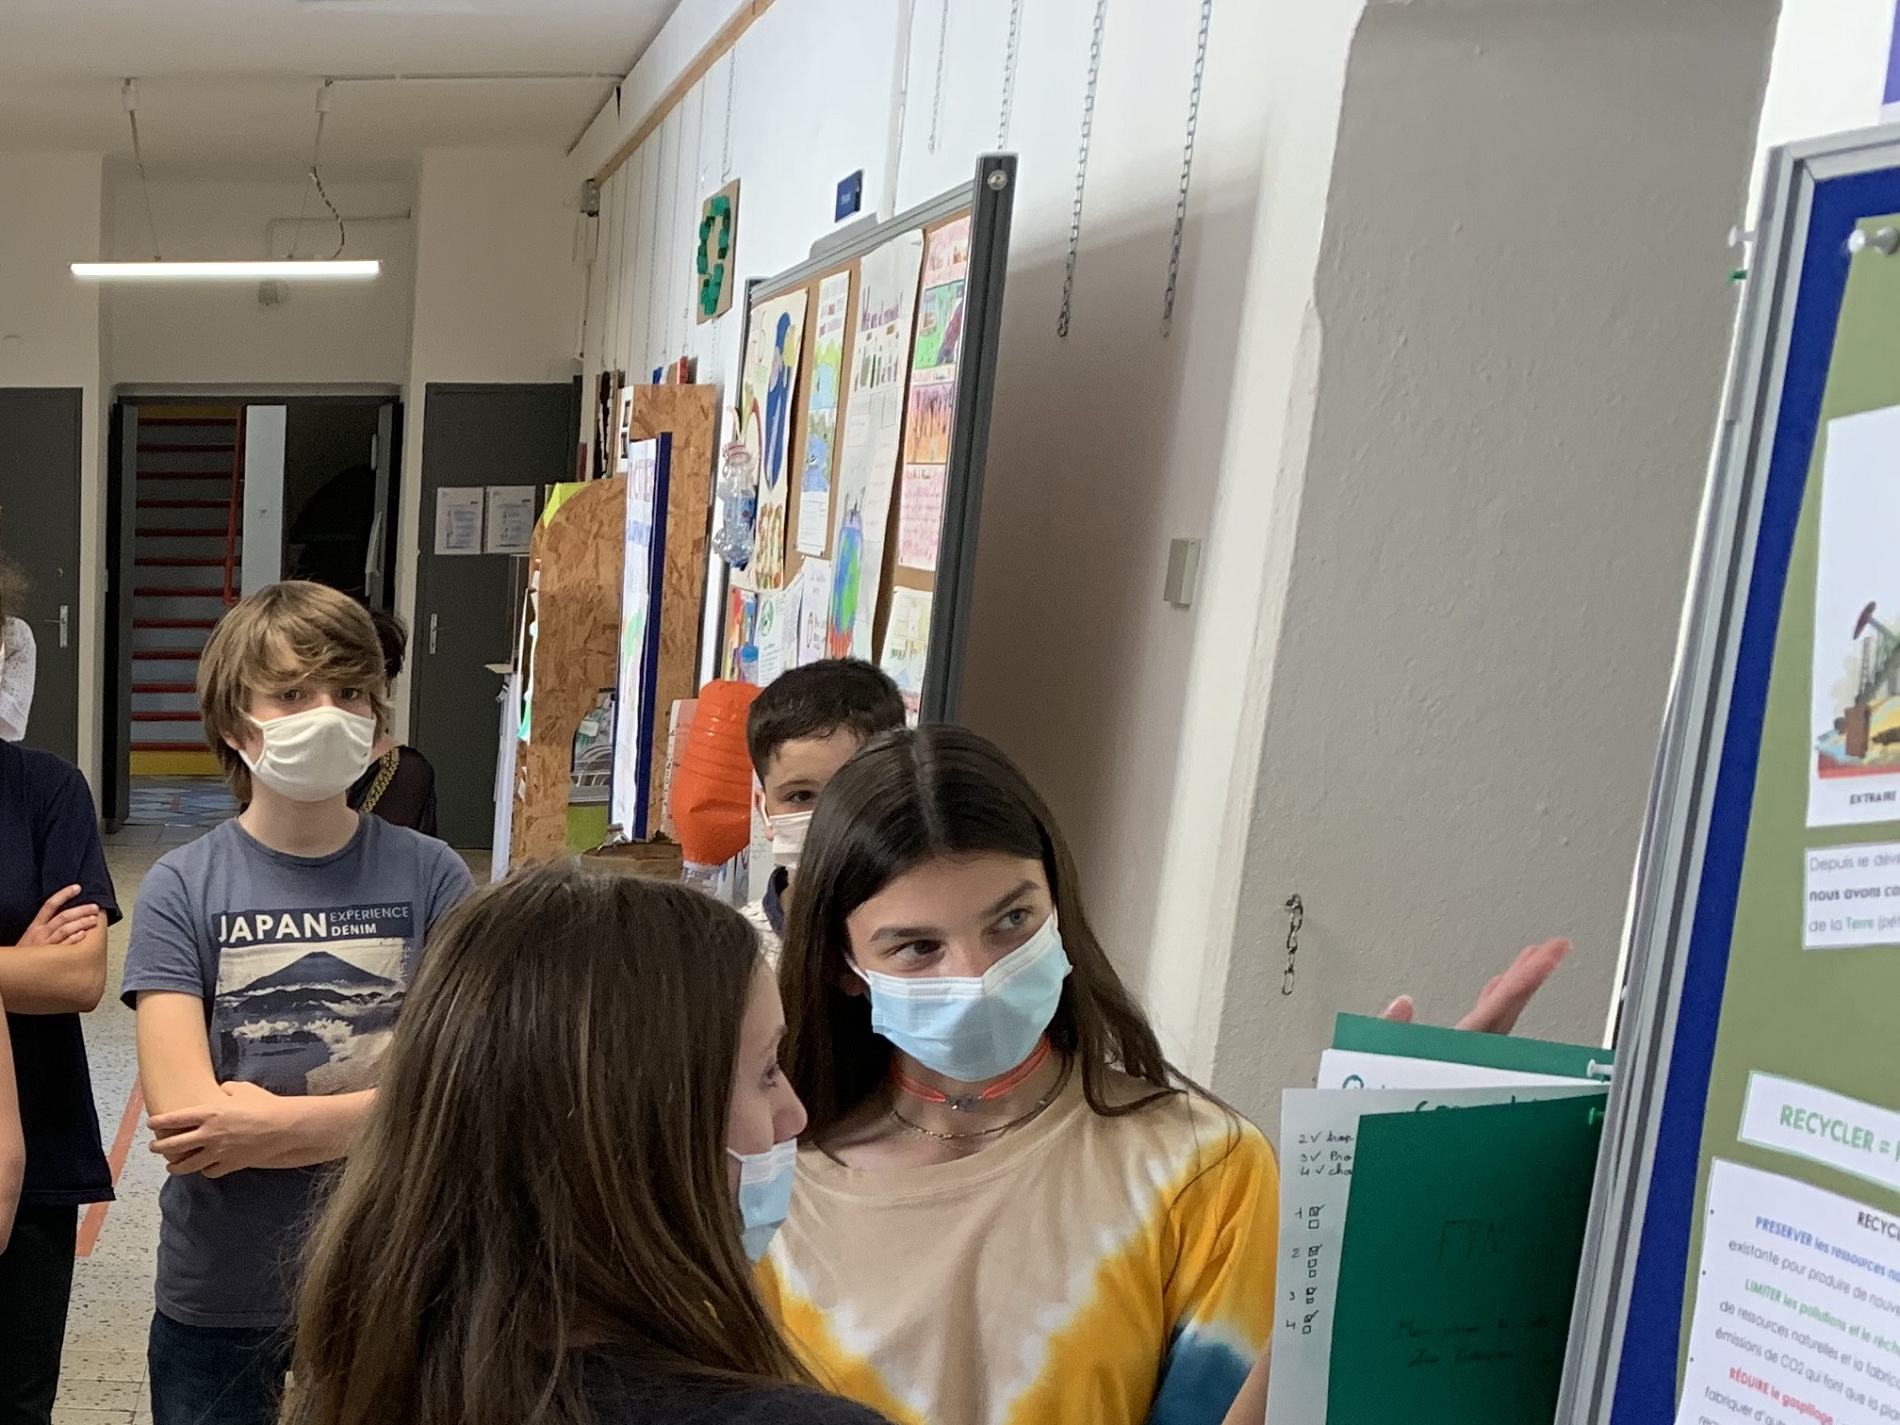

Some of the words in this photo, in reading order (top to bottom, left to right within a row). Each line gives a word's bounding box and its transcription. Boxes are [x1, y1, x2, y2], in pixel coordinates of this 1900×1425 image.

[1809, 855, 1854, 872] Depuis
[1809, 889, 1840, 902] nous
[1844, 886, 1882, 900] avons
[218, 912, 328, 944] JAPAN
[330, 906, 409, 923] EXPERIENCE
[331, 923, 377, 938] DENIM
[1779, 1103, 1875, 1153] RECYCLER
[1755, 1215, 1813, 1247] PRESERVER
[1815, 1236, 1829, 1254] les
[1831, 1245, 1886, 1277] ressources
[1728, 1238, 1780, 1265] existante
[1781, 1257, 1807, 1276] pour
[1808, 1267, 1851, 1294] produire
[1852, 1286, 1868, 1302] de
[1744, 1278, 1783, 1303] LIMITER
[1783, 1293, 1798, 1310] les
[1848, 1324, 1861, 1338] et
[1861, 1327, 1872, 1343] le
[1719, 1299, 1736, 1315] de
[1737, 1306, 1790, 1339] ressources
[1790, 1329, 1839, 1361] naturelles
[1840, 1352, 1852, 1366] et
[1853, 1356, 1864, 1373] la
[1715, 1326, 1763, 1358] émissions
[1764, 1347, 1779, 1363] de
[1780, 1353, 1805, 1375] CO2
[1805, 1367, 1822, 1385] qui
[1823, 1373, 1844, 1394] font
[1844, 1385, 1866, 1405] que
[1867, 1393, 1878, 1411] la
[1729, 1365, 1770, 1395] RÉDUIRE
[1771, 1385, 1780, 1400] le
[1704, 1385, 1754, 1417] fabriquer
